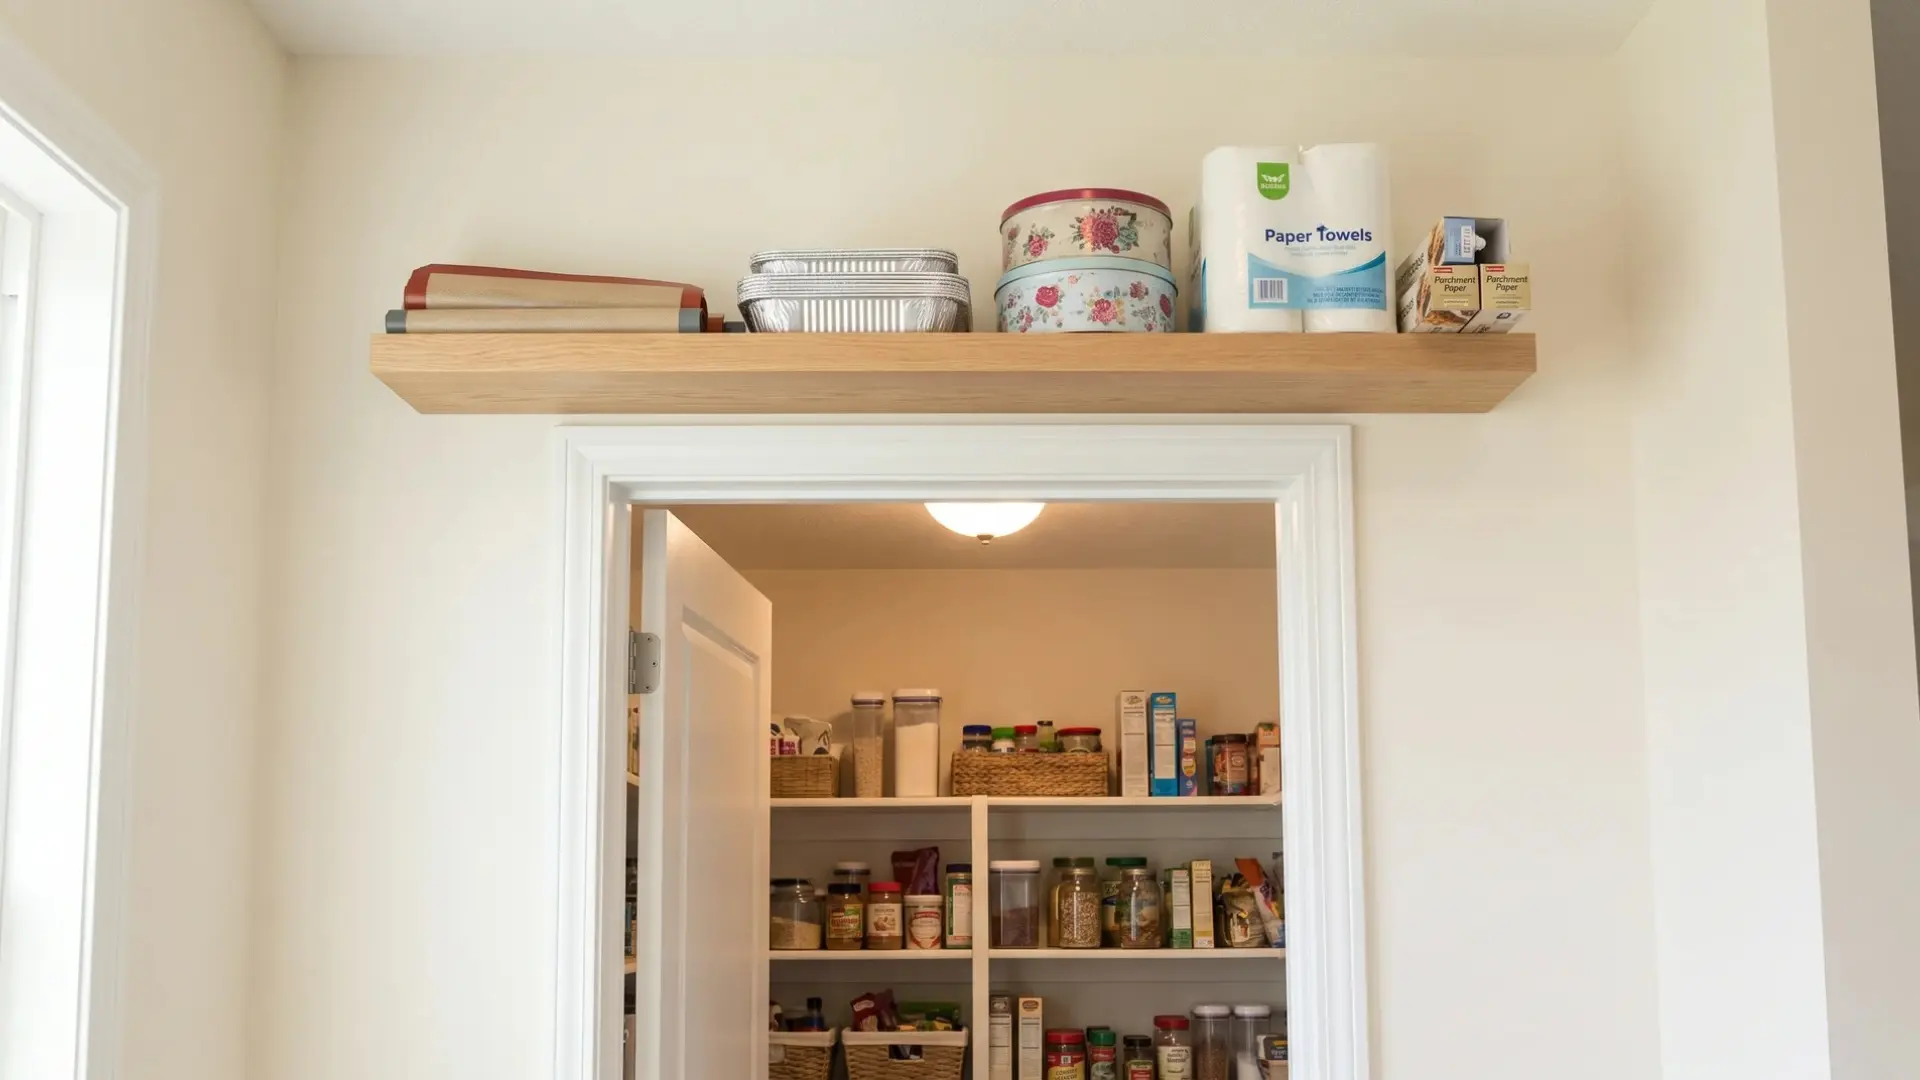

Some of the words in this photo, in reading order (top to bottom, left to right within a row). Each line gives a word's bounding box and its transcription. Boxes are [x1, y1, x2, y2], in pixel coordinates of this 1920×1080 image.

[1265, 229, 1312, 245] Paper
[1316, 225, 1372, 241] Towels
[1434, 276, 1476, 284] Parchment
[1486, 275, 1528, 283] Parchment
[1444, 284, 1467, 293] Paper
[1495, 283, 1518, 292] Paper
